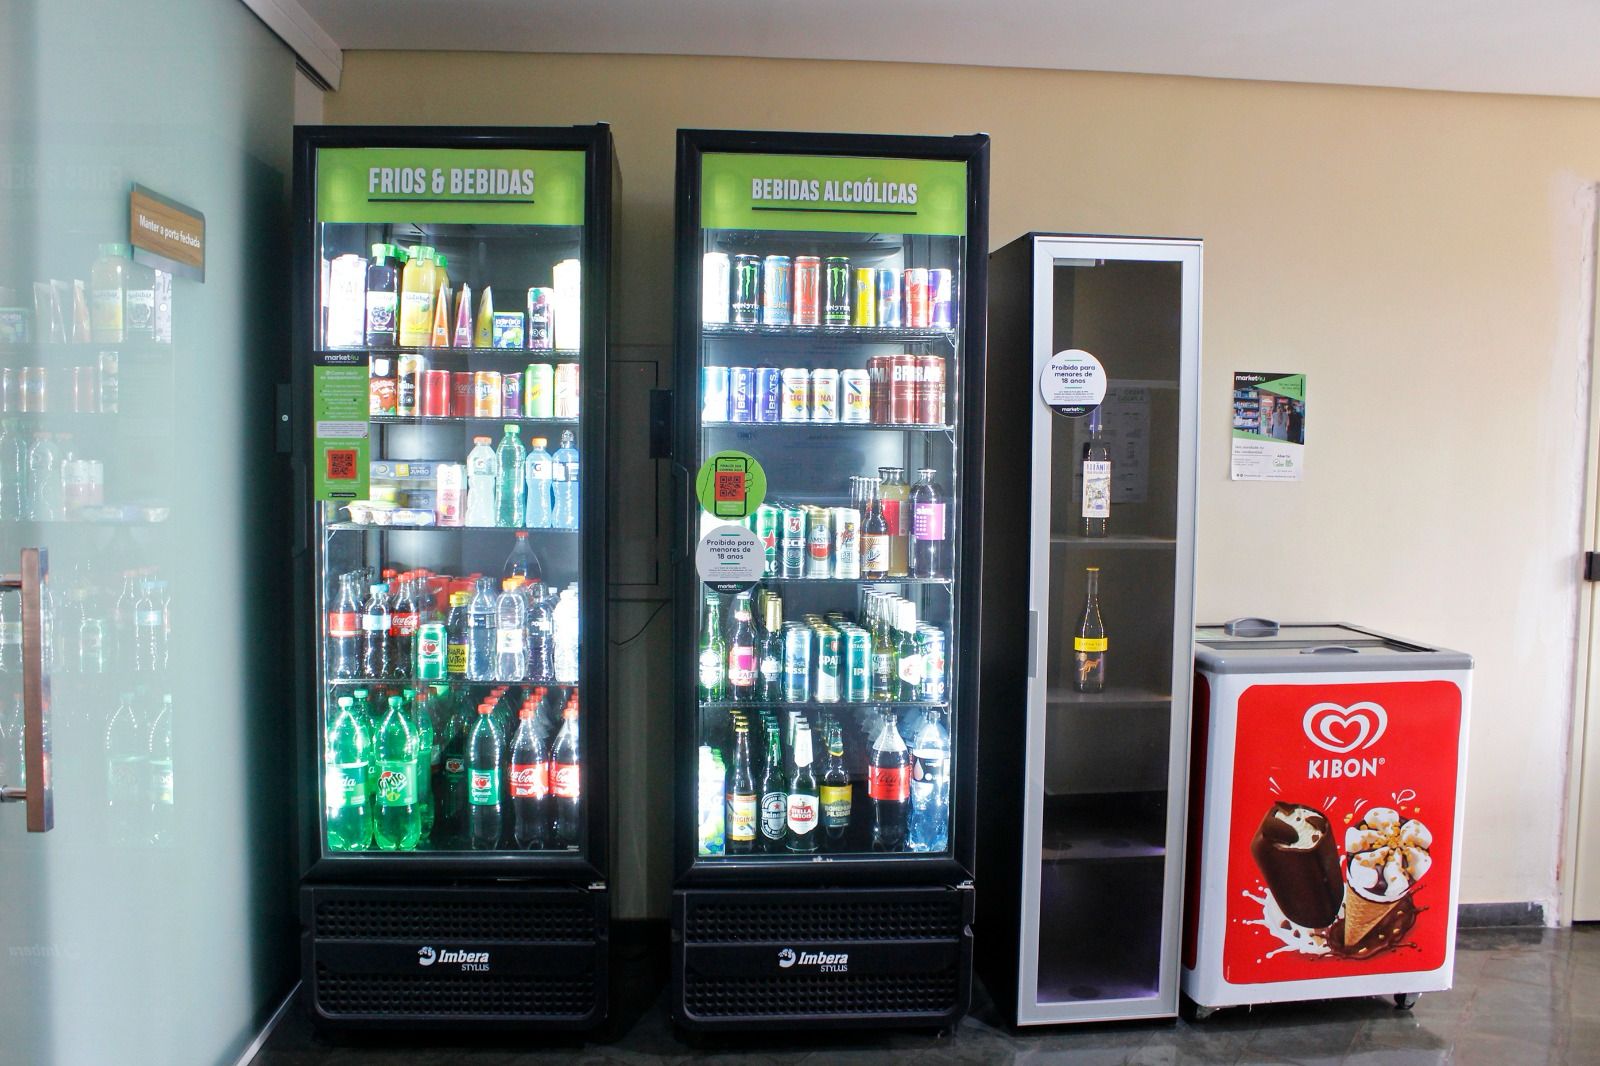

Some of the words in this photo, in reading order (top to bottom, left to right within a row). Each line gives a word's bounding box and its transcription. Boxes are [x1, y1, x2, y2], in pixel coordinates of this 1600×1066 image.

[369, 167, 425, 195] FRIOS
[431, 168, 446, 195] &
[450, 169, 535, 196] BEBIDAS
[752, 178, 820, 202] BEBIDAS
[823, 177, 919, 205] ALCOÓLICAS
[139, 214, 159, 232] Manter
[160, 226, 164, 235] a
[164, 228, 180, 240] porta
[179, 231, 201, 248] fechada
[738, 373, 746, 410] BEATS
[769, 375, 777, 411] BEATS
[706, 538, 737, 547] Proibido
[737, 540, 755, 548] para
[742, 546, 752, 554] de
[1307, 757, 1378, 779] KIBON
[438, 949, 490, 964] Imbera
[798, 951, 849, 965] Imbera
[461, 963, 490, 972] STYLUS
[820, 964, 848, 973] STYLUS
